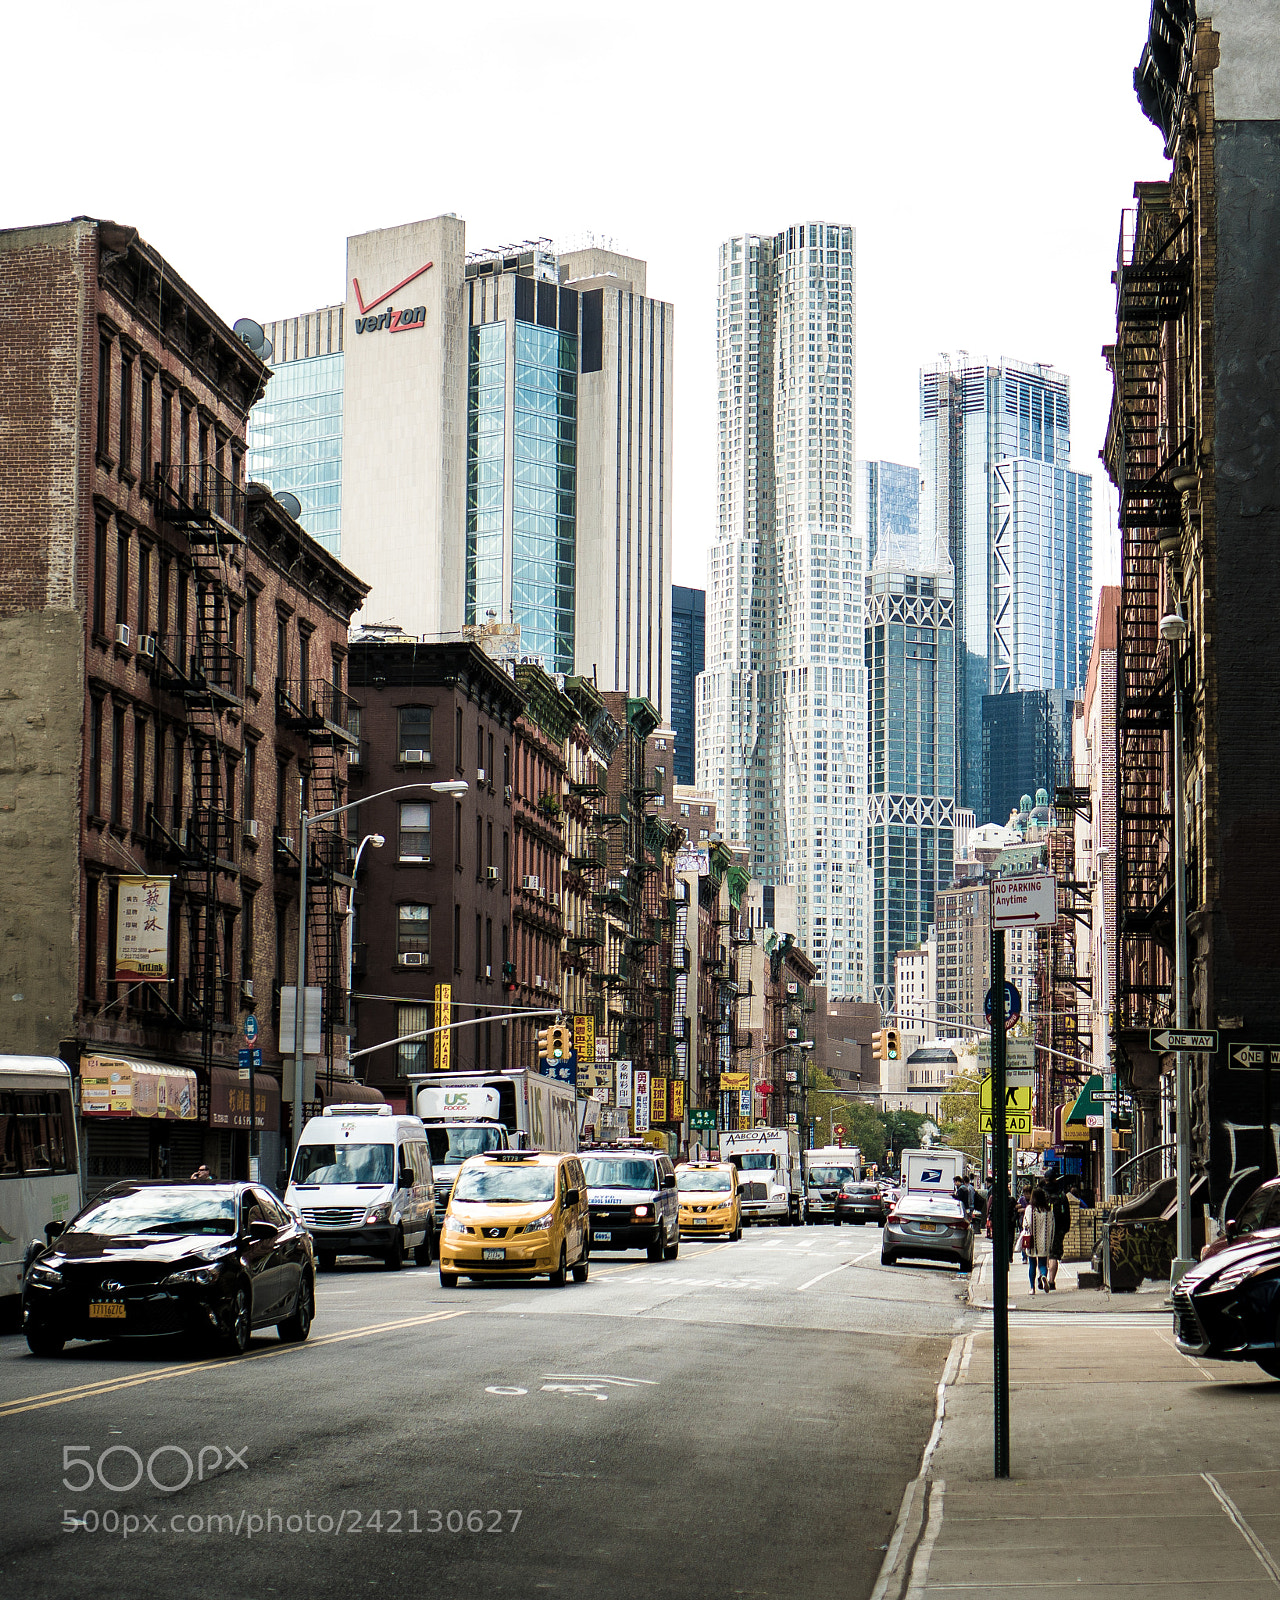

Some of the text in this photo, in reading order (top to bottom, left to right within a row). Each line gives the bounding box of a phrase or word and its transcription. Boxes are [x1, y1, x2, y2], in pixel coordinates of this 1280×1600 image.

[355, 306, 426, 333] verizon
[995, 882, 1042, 894] NO PARKING
[996, 895, 1028, 907] Anytime
[1168, 1035, 1211, 1046] ONE WAY
[1240, 1051, 1262, 1062] ONE
[653, 1079, 665, 1120] 環球網吧
[986, 1117, 1026, 1129] AEAD
